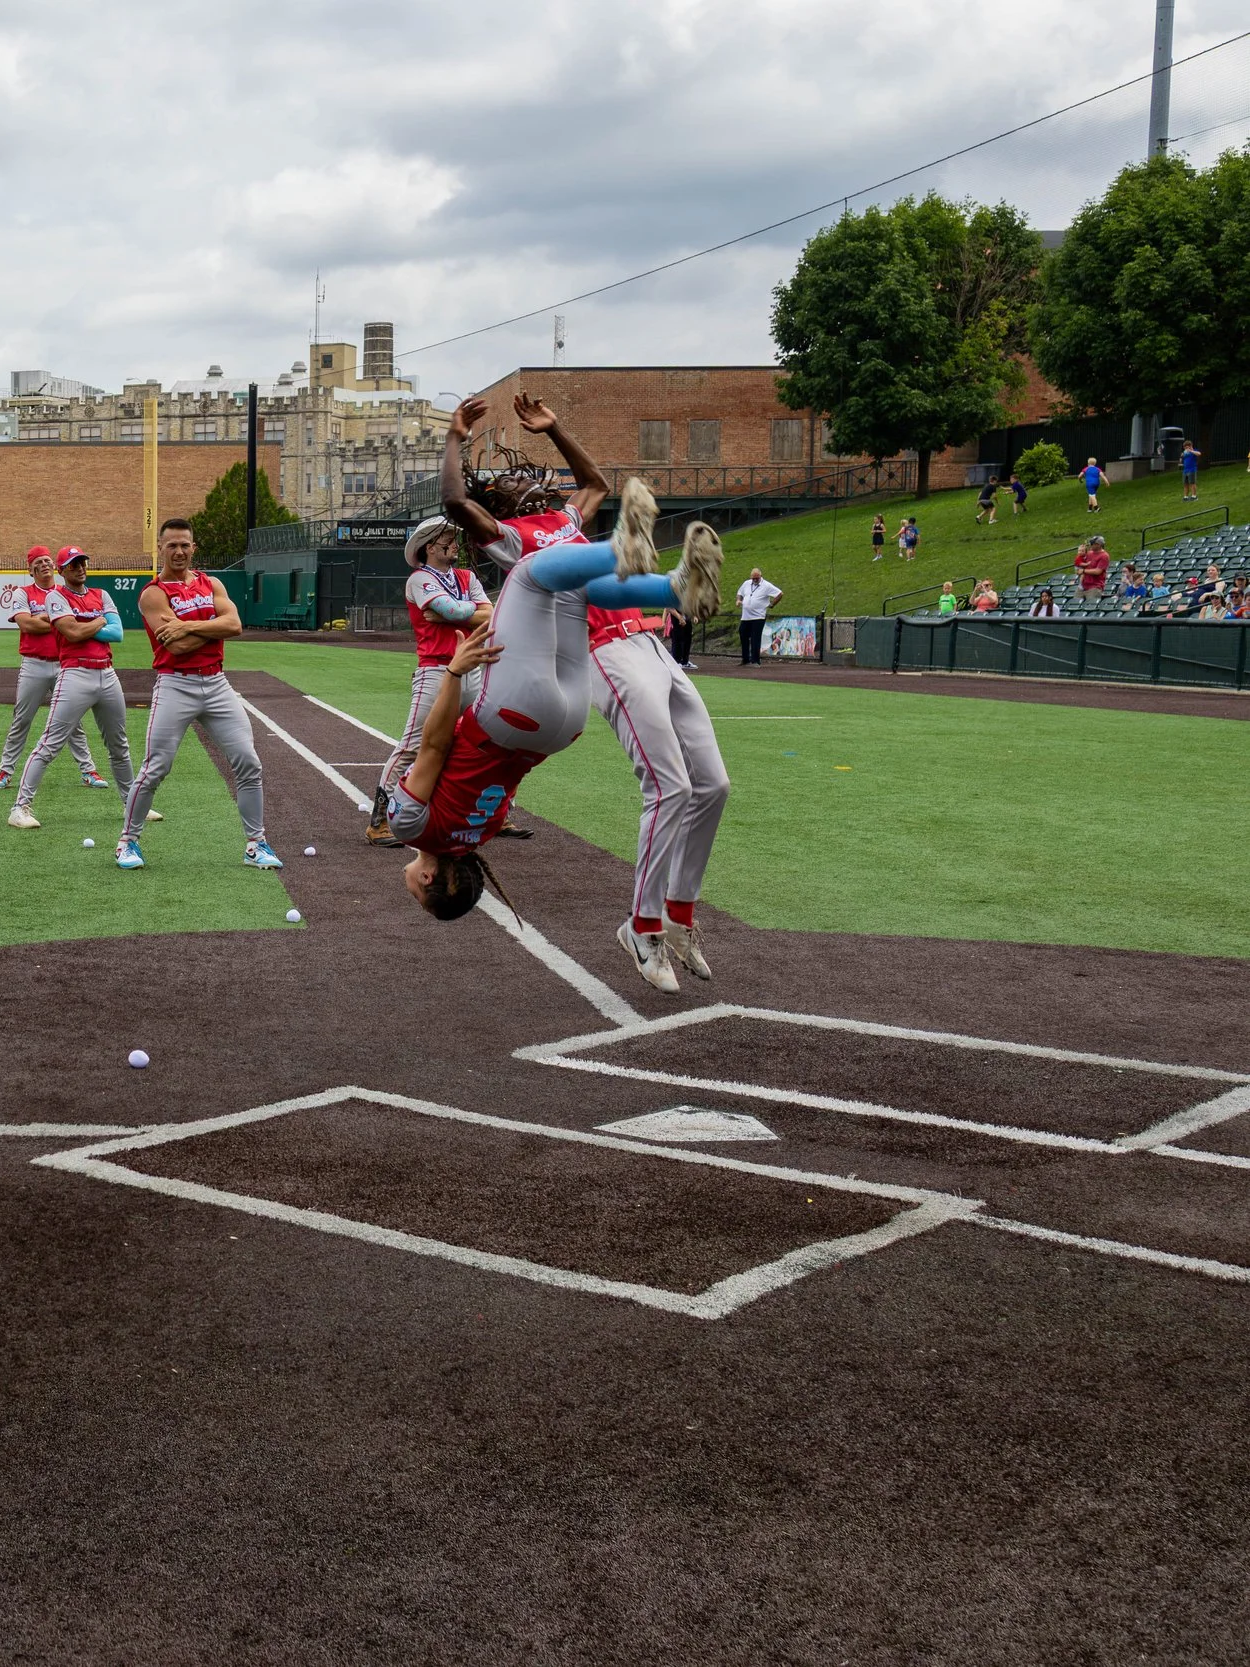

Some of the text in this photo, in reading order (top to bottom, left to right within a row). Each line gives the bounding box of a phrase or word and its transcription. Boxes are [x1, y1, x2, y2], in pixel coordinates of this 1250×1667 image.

[364, 527, 386, 537] JOLIET
[386, 527, 406, 537] PRISON
[114, 578, 138, 590] 327
